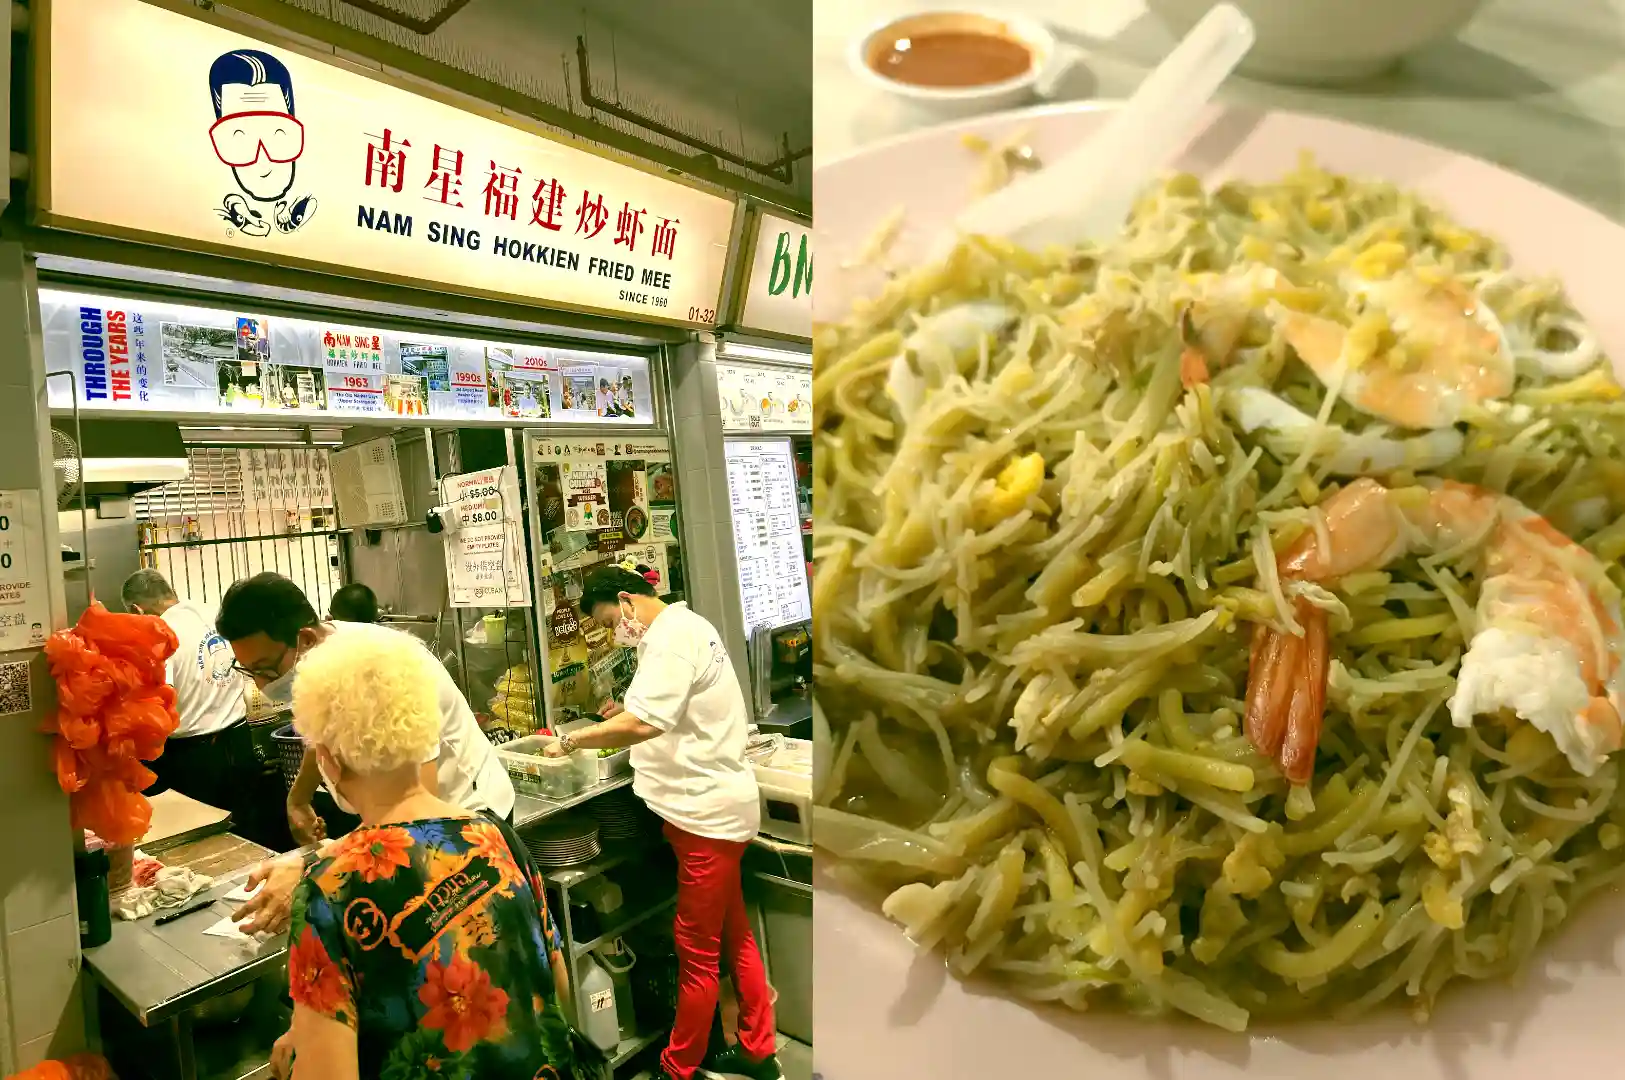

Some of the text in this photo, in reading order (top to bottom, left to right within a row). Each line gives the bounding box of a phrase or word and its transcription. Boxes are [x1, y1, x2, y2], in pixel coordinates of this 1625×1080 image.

[364, 128, 680, 260] 南星福建炒虾面
[357, 205, 671, 289] NAM SING HOKKIEN FRIED MEE
[619, 290, 668, 308] SINCE 1960
[688, 306, 715, 323] 01-32
[80, 307, 107, 401] THROUGH
[107, 310, 131, 401] THE YEARS
[525, 357, 548, 366] 2010s
[344, 376, 369, 387] 1963
[456, 372, 482, 382] 1990s
[470, 486, 494, 499] $5.00
[462, 511, 497, 526] 中 $8.00
